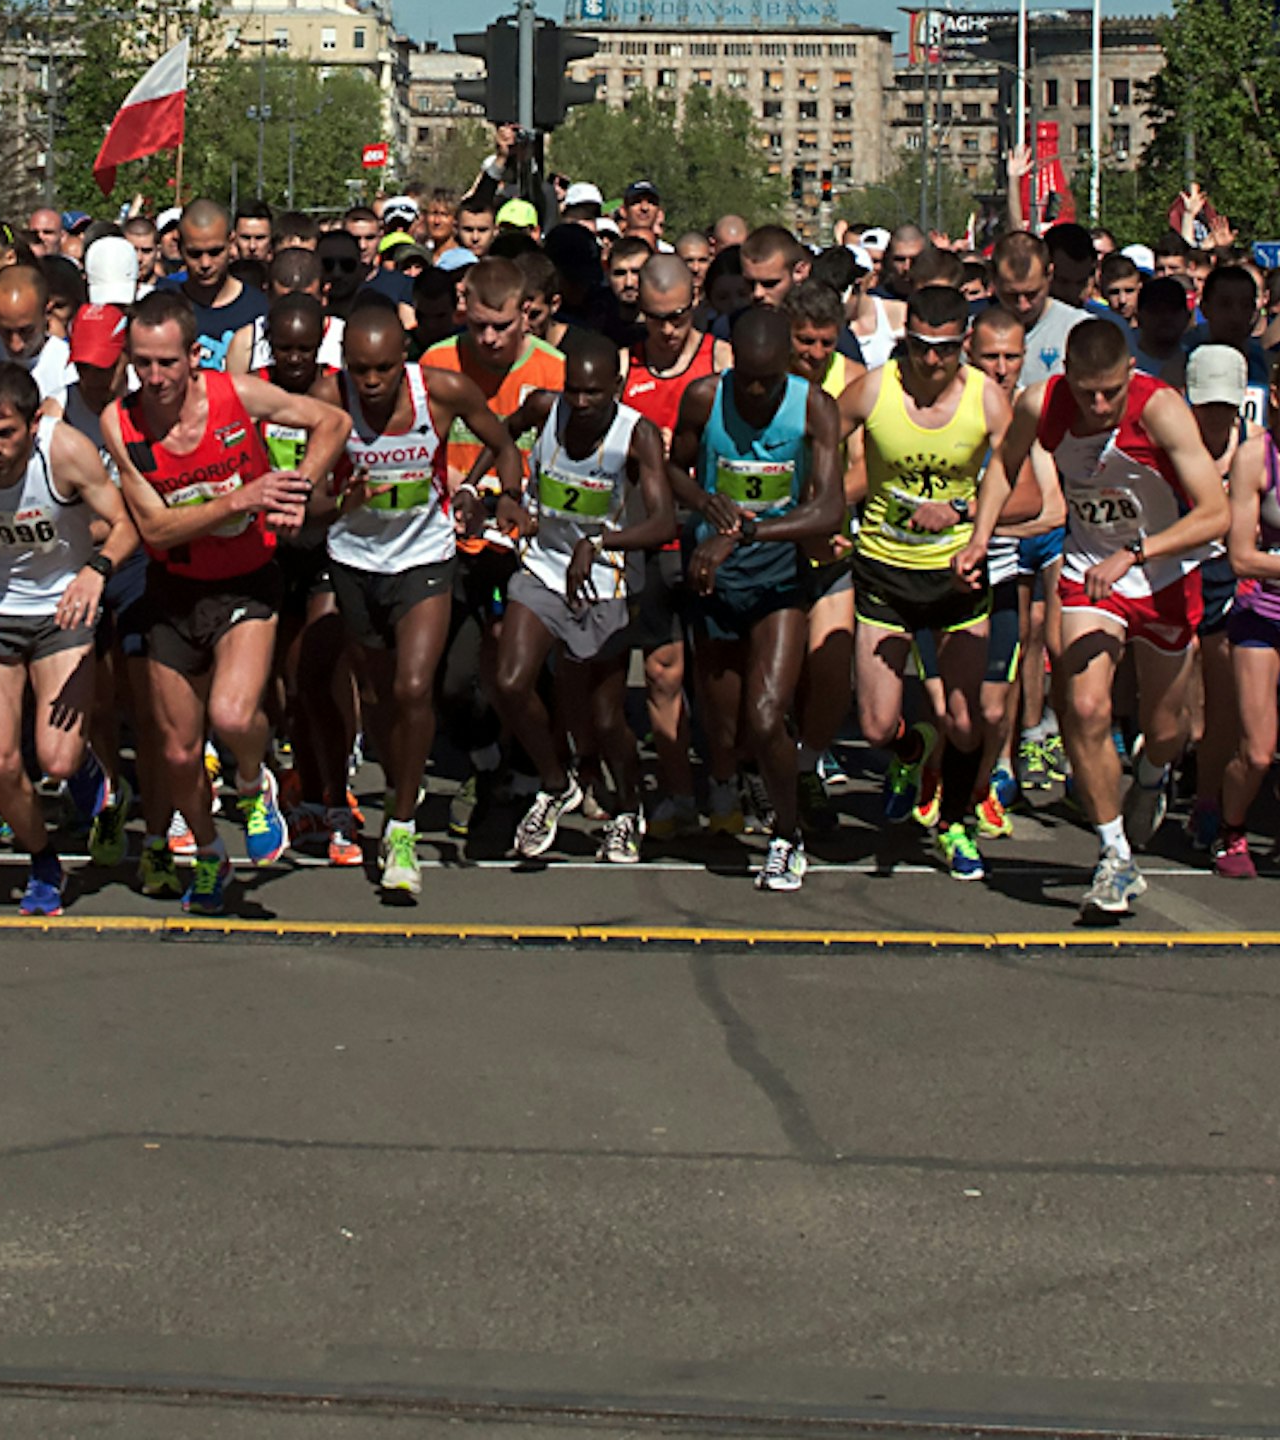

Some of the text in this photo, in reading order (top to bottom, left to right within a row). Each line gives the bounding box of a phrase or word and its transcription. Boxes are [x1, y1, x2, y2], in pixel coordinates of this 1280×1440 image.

[352, 446, 429, 464] TOYOTA
[390, 485, 399, 509] 1
[746, 476, 763, 499] 3
[563, 488, 580, 511] 2
